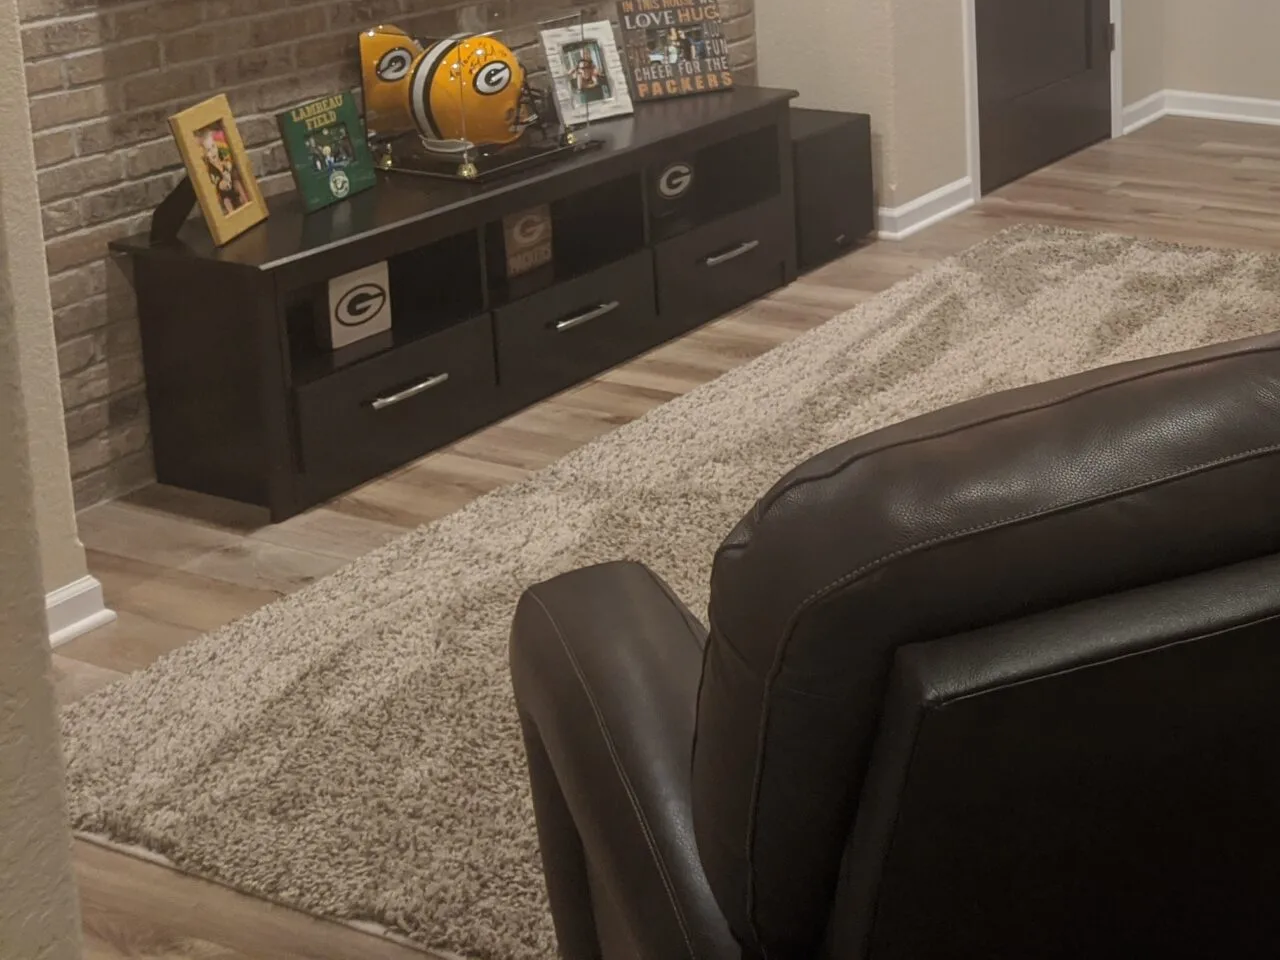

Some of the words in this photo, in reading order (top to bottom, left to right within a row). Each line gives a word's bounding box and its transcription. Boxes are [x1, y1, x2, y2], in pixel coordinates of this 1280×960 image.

[624, 10, 674, 30] LOVE
[705, 39, 729, 56] FUN
[634, 63, 672, 82] CHEER
[678, 60, 701, 75] FOR
[704, 55, 729, 73] THE
[637, 71, 734, 99] PACKERS
[291, 94, 343, 123] LAMBEAU
[305, 110, 337, 131] FIELD
[659, 164, 692, 197] G
[335, 283, 387, 327] G
